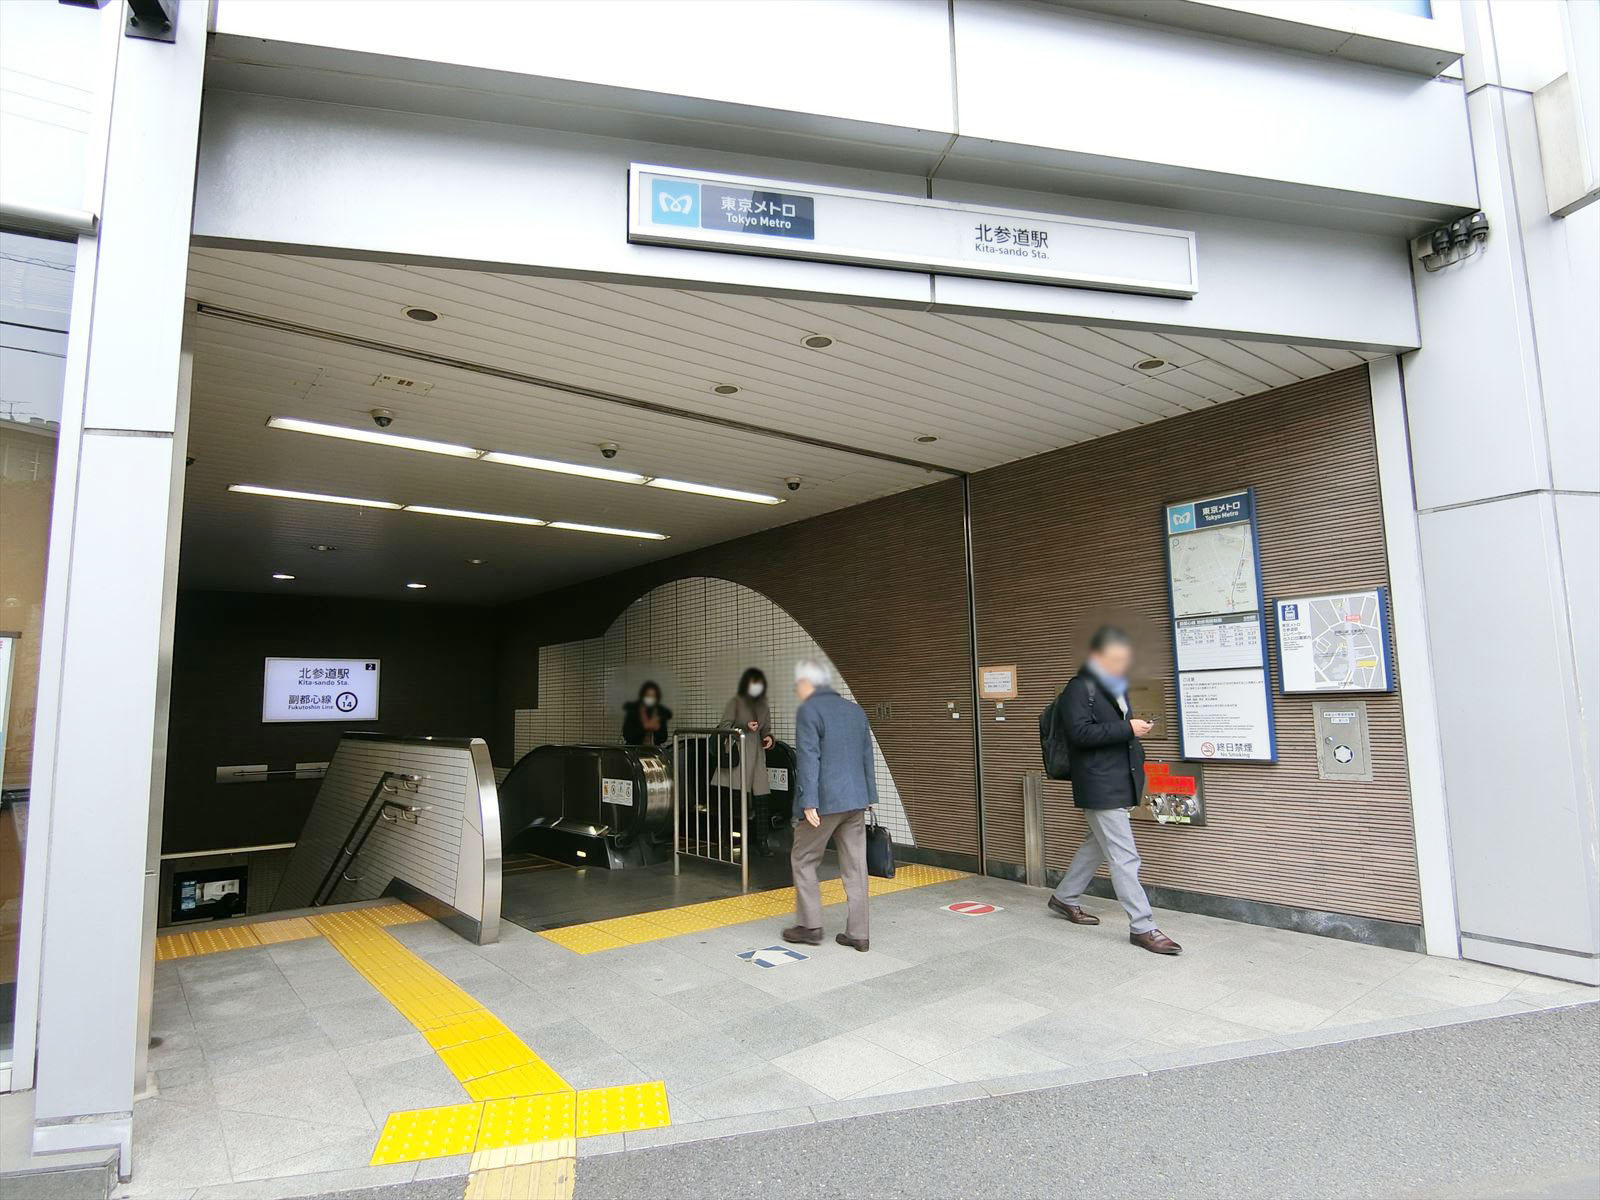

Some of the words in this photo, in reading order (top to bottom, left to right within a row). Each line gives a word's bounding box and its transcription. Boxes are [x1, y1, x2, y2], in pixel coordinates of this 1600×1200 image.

[721, 196, 796, 217] 東京メトロ
[726, 212, 758, 226] Tokyo
[760, 216, 792, 229] Metro
[974, 223, 1049, 249] 北参道駅
[975, 243, 1029, 257] Kita-sando
[1031, 249, 1051, 260] Sta.
[1202, 501, 1241, 516] 東京メトロ
[1204, 513, 1222, 521] Tokyo
[1222, 511, 1239, 519] Metro
[299, 667, 350, 680] 北参道駅
[288, 694, 332, 705] 副都心線
[1216, 742, 1254, 753] 終日禁煙
